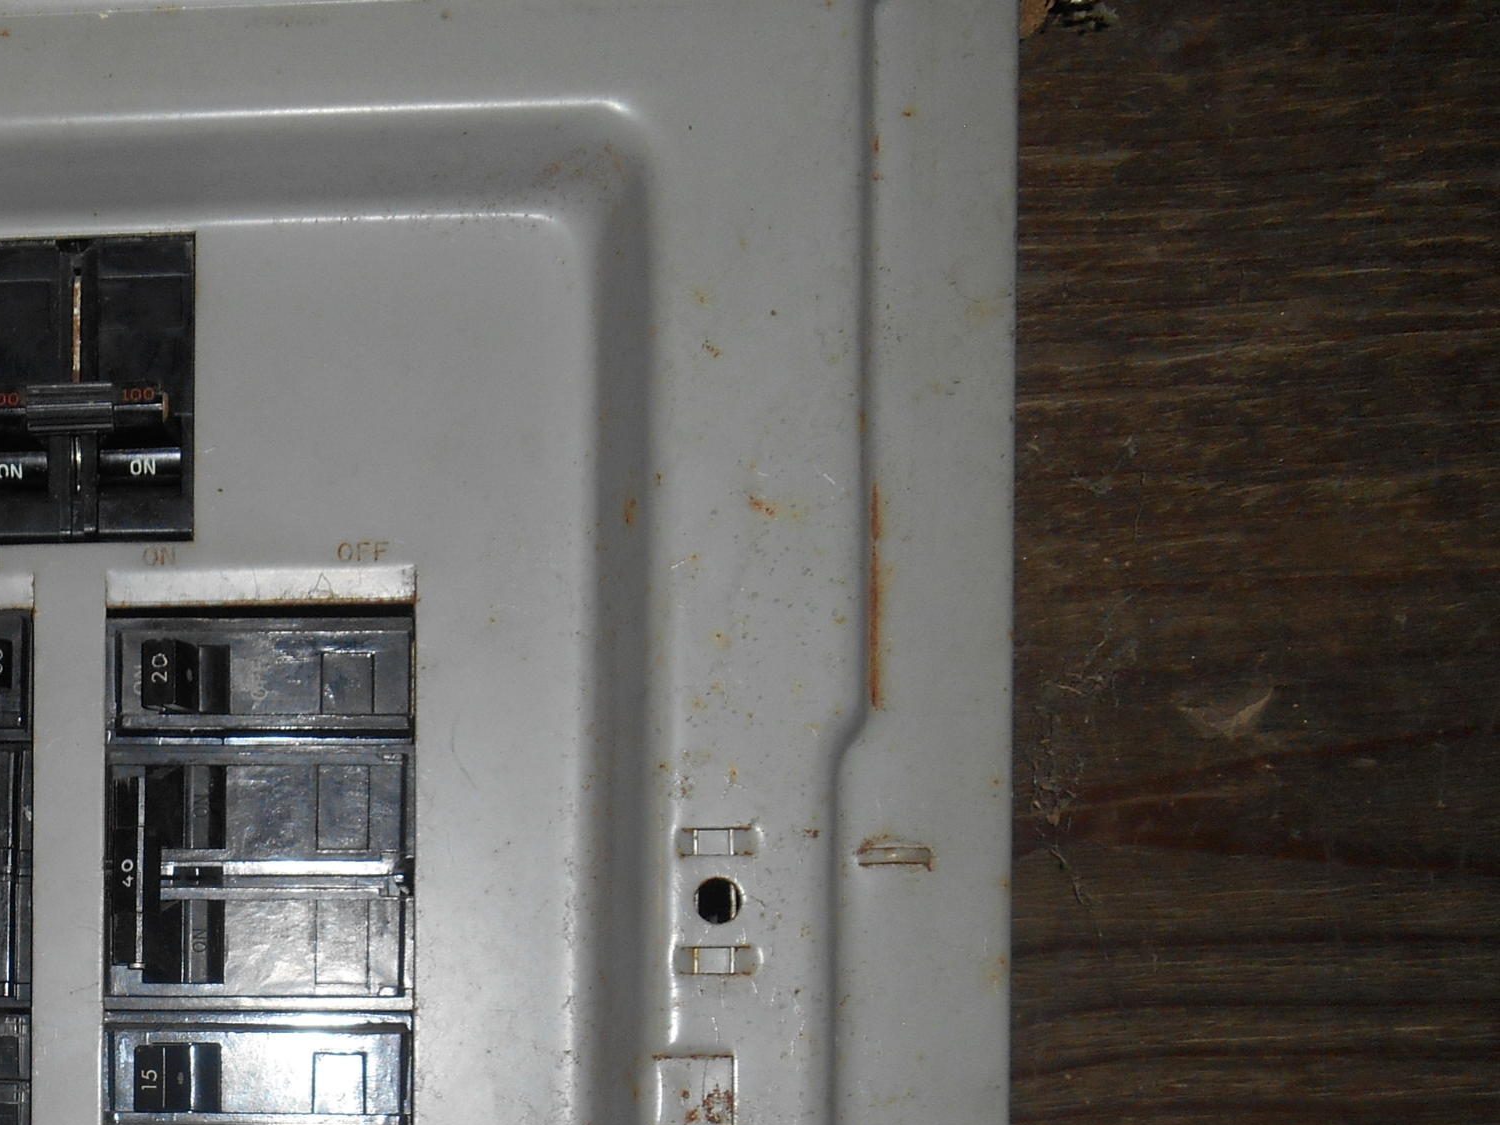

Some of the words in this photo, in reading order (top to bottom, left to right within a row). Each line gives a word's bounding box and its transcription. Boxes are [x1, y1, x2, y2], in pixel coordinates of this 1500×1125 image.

[122, 387, 155, 402] 100
[130, 460, 156, 476] ON
[142, 547, 177, 567] ON
[337, 542, 390, 562] OFF
[151, 652, 168, 684] 20
[122, 858, 134, 889] 40
[141, 1068, 158, 1090] 15
